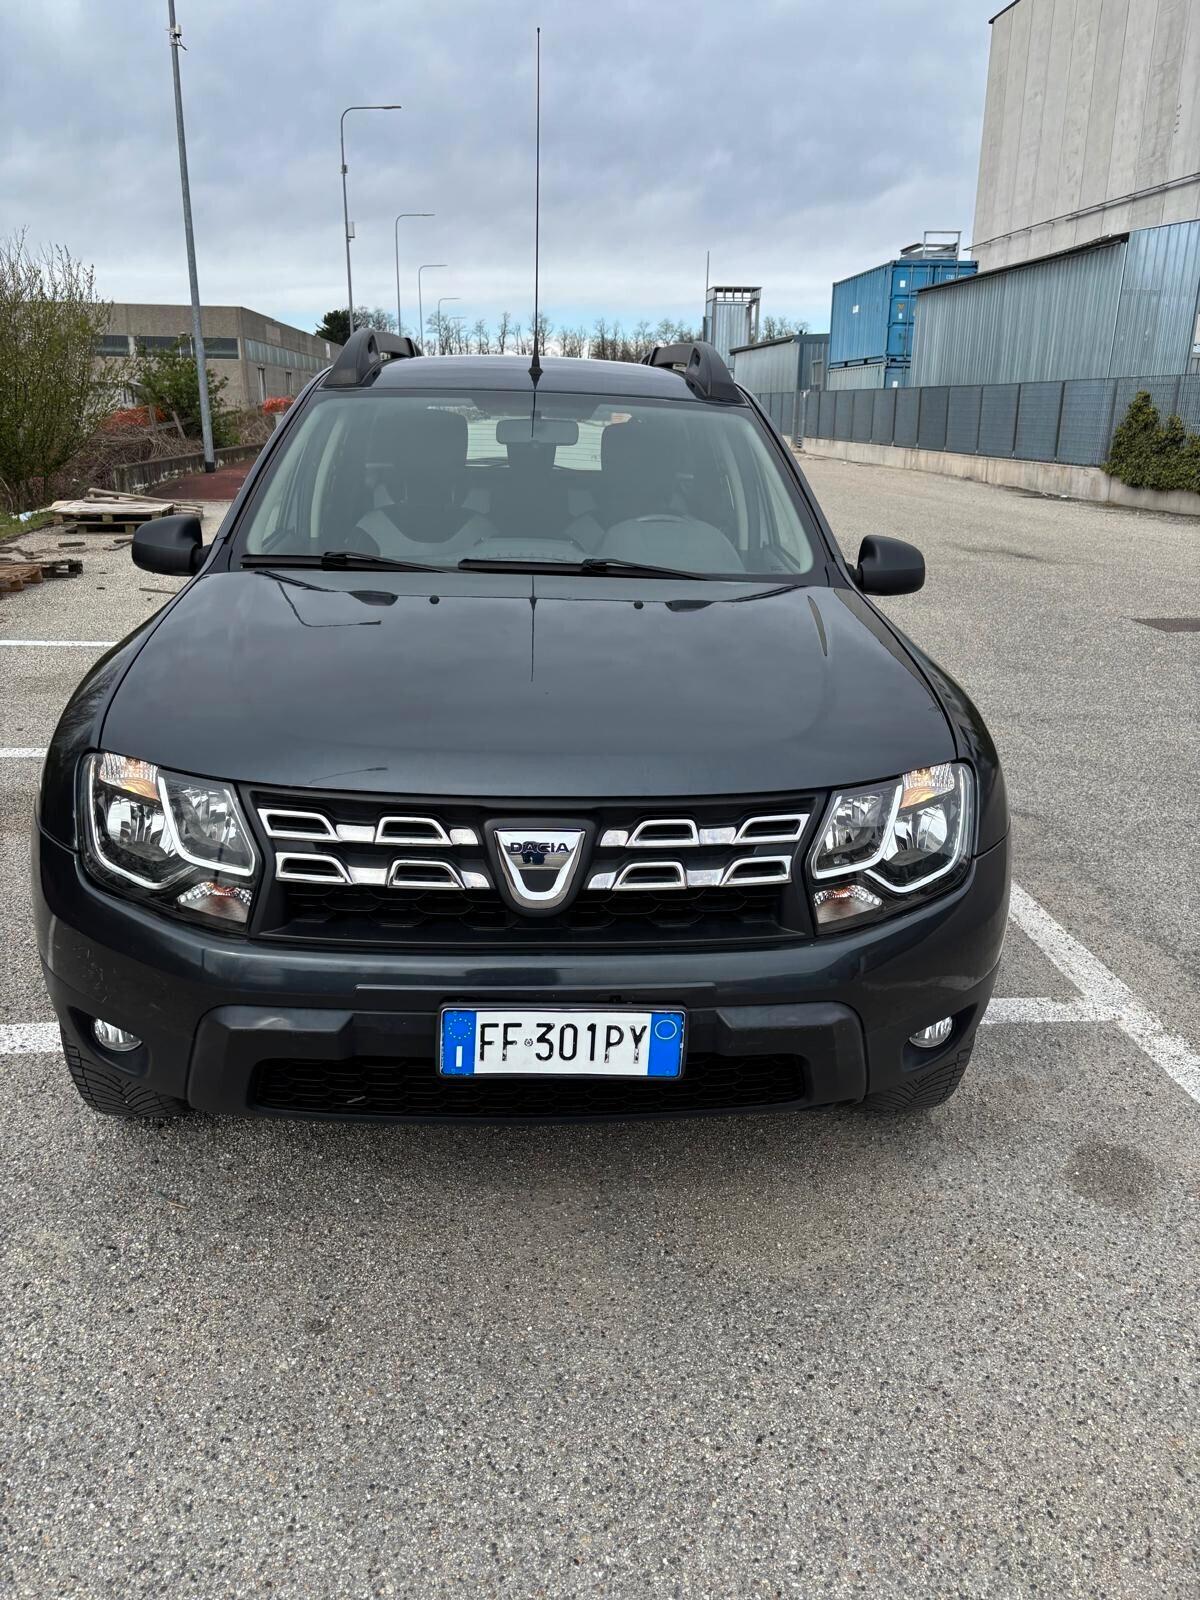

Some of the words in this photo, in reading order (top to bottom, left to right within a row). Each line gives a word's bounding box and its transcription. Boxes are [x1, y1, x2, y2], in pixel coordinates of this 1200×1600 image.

[509, 842, 570, 853] DACIA
[479, 1023, 522, 1061] FF
[535, 1023, 648, 1064] 301PY
[455, 1046, 463, 1067] I
